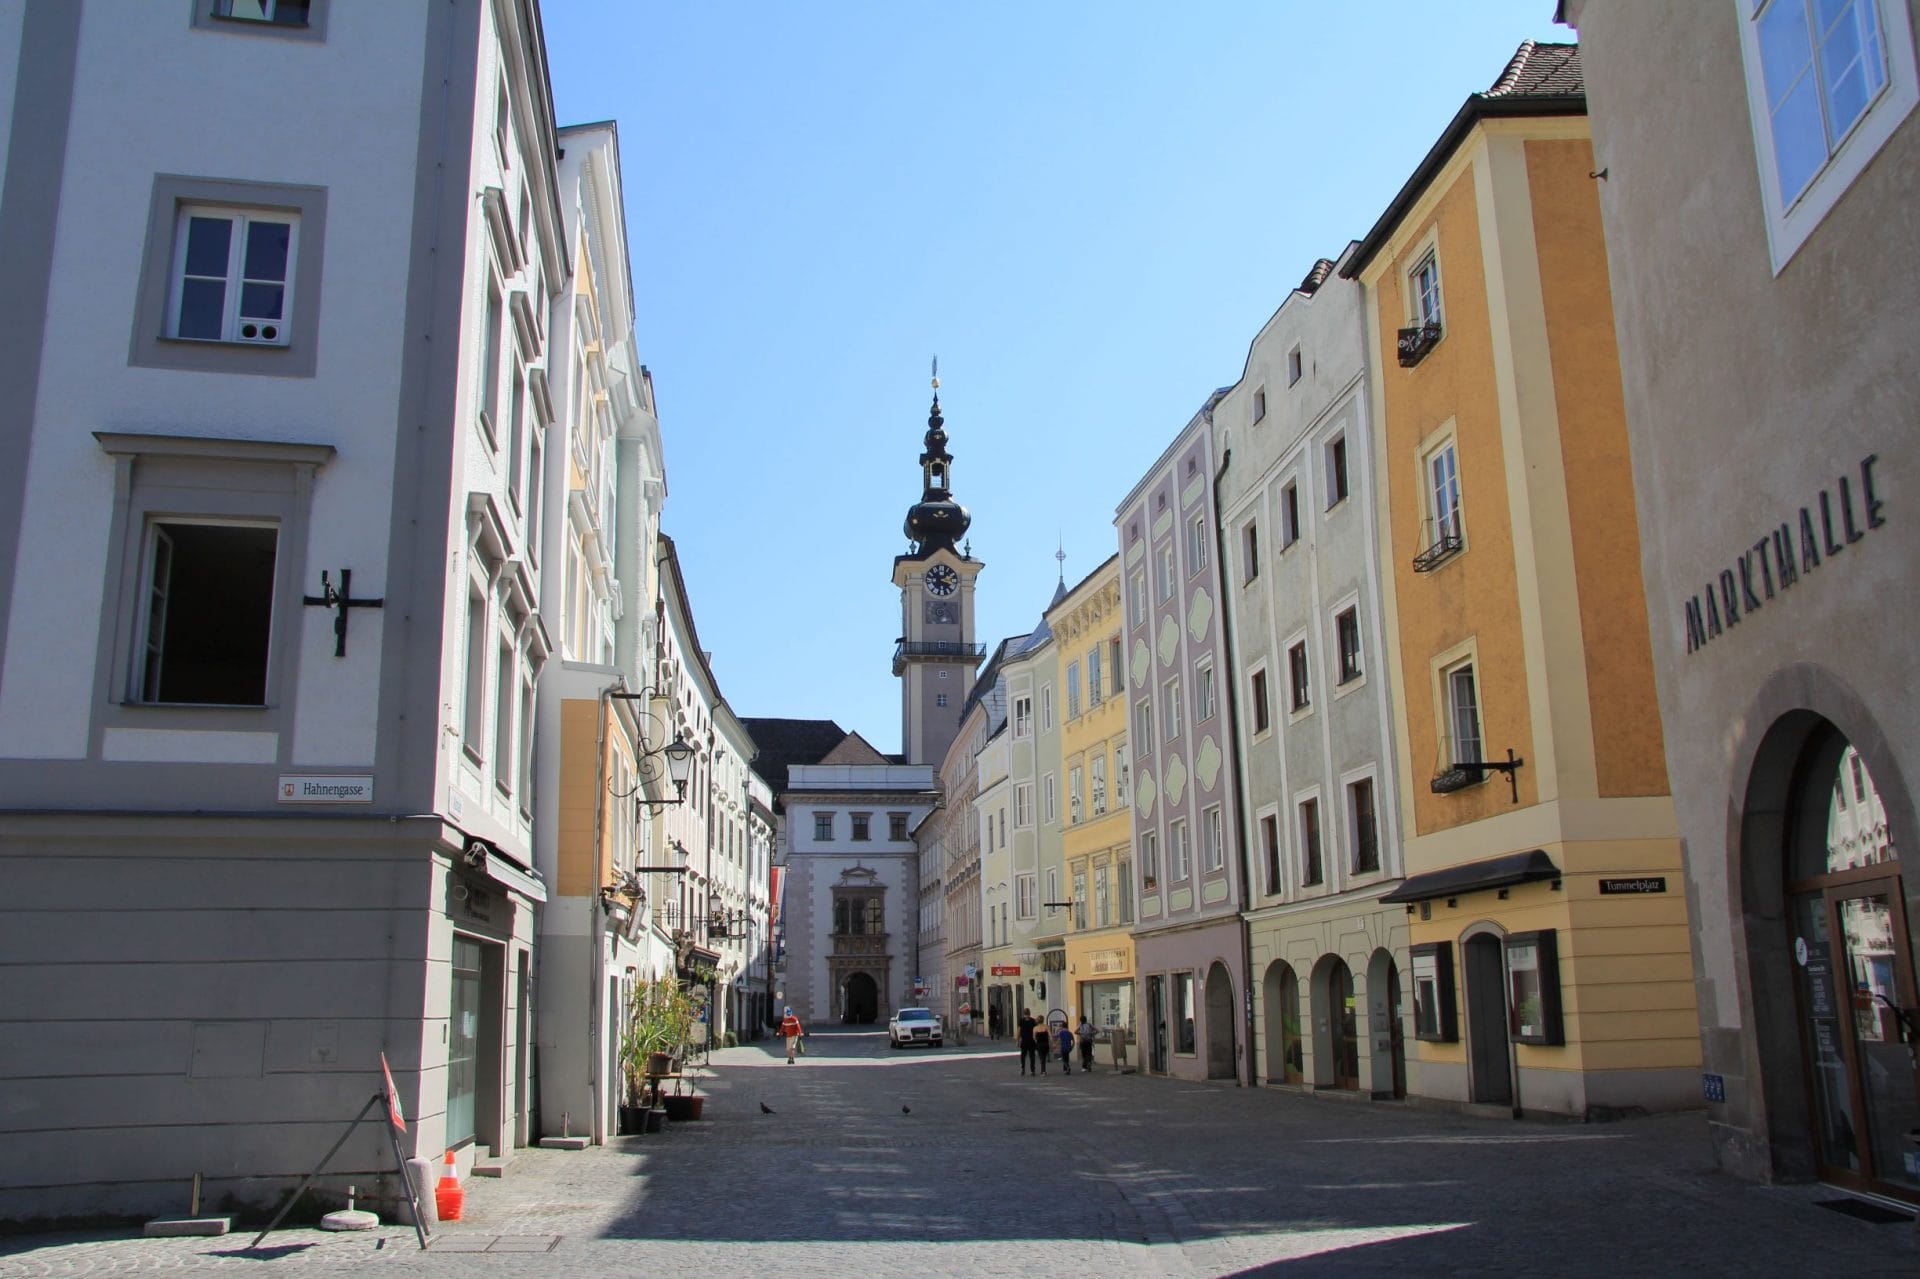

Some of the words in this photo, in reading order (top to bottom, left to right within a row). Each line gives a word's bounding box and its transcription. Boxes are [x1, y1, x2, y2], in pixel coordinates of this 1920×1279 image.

[1685, 454, 1886, 655] MARKTHALLE
[303, 782, 363, 798] Hahnengasse
[1606, 880, 1659, 891] Tummelplatz
